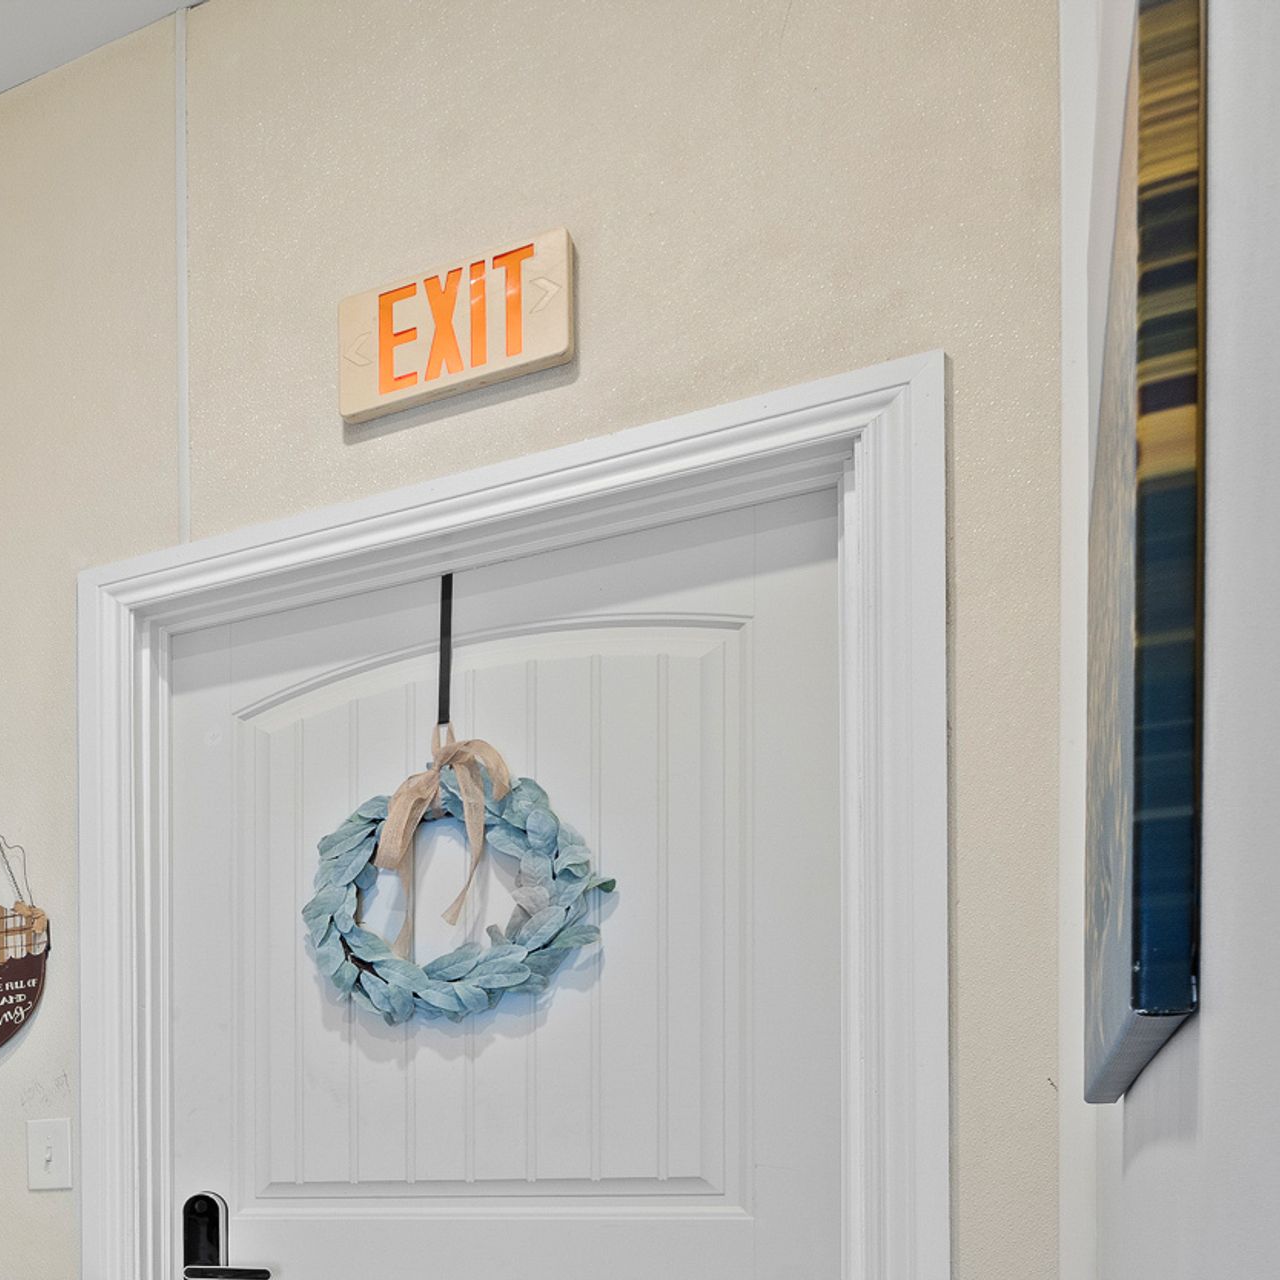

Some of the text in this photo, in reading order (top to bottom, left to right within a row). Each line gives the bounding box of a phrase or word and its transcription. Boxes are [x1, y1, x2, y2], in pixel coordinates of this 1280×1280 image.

[378, 243, 534, 395] EXIT
[5, 981, 26, 991] FULL
[27, 978, 38, 988] OF
[0, 993, 26, 1005] AND
